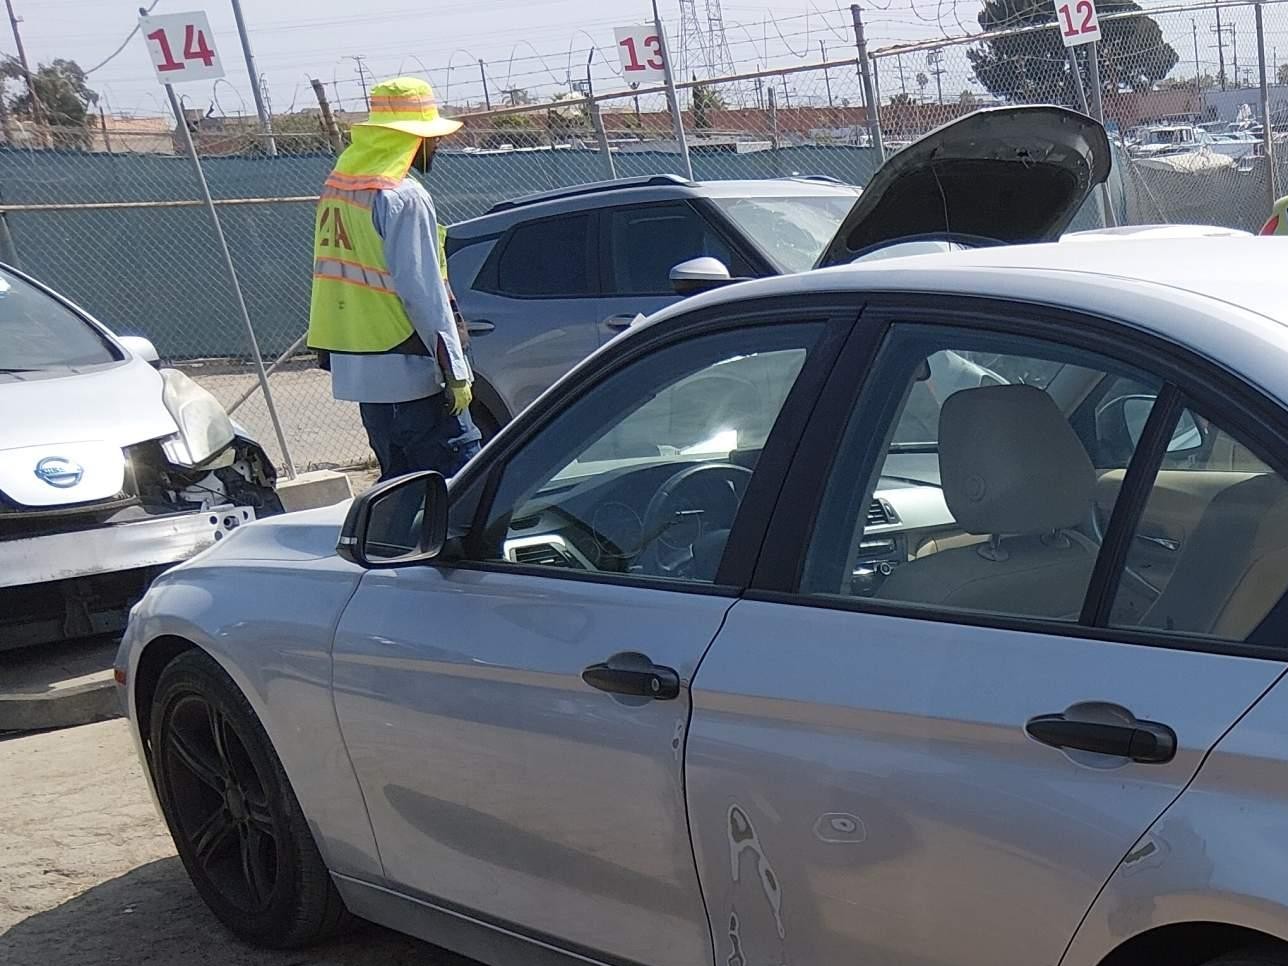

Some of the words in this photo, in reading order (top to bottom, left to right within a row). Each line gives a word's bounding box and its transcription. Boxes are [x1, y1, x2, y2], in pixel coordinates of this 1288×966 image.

[1059, 1, 1098, 37] 12
[147, 25, 215, 72] 14
[619, 35, 665, 71] 13
